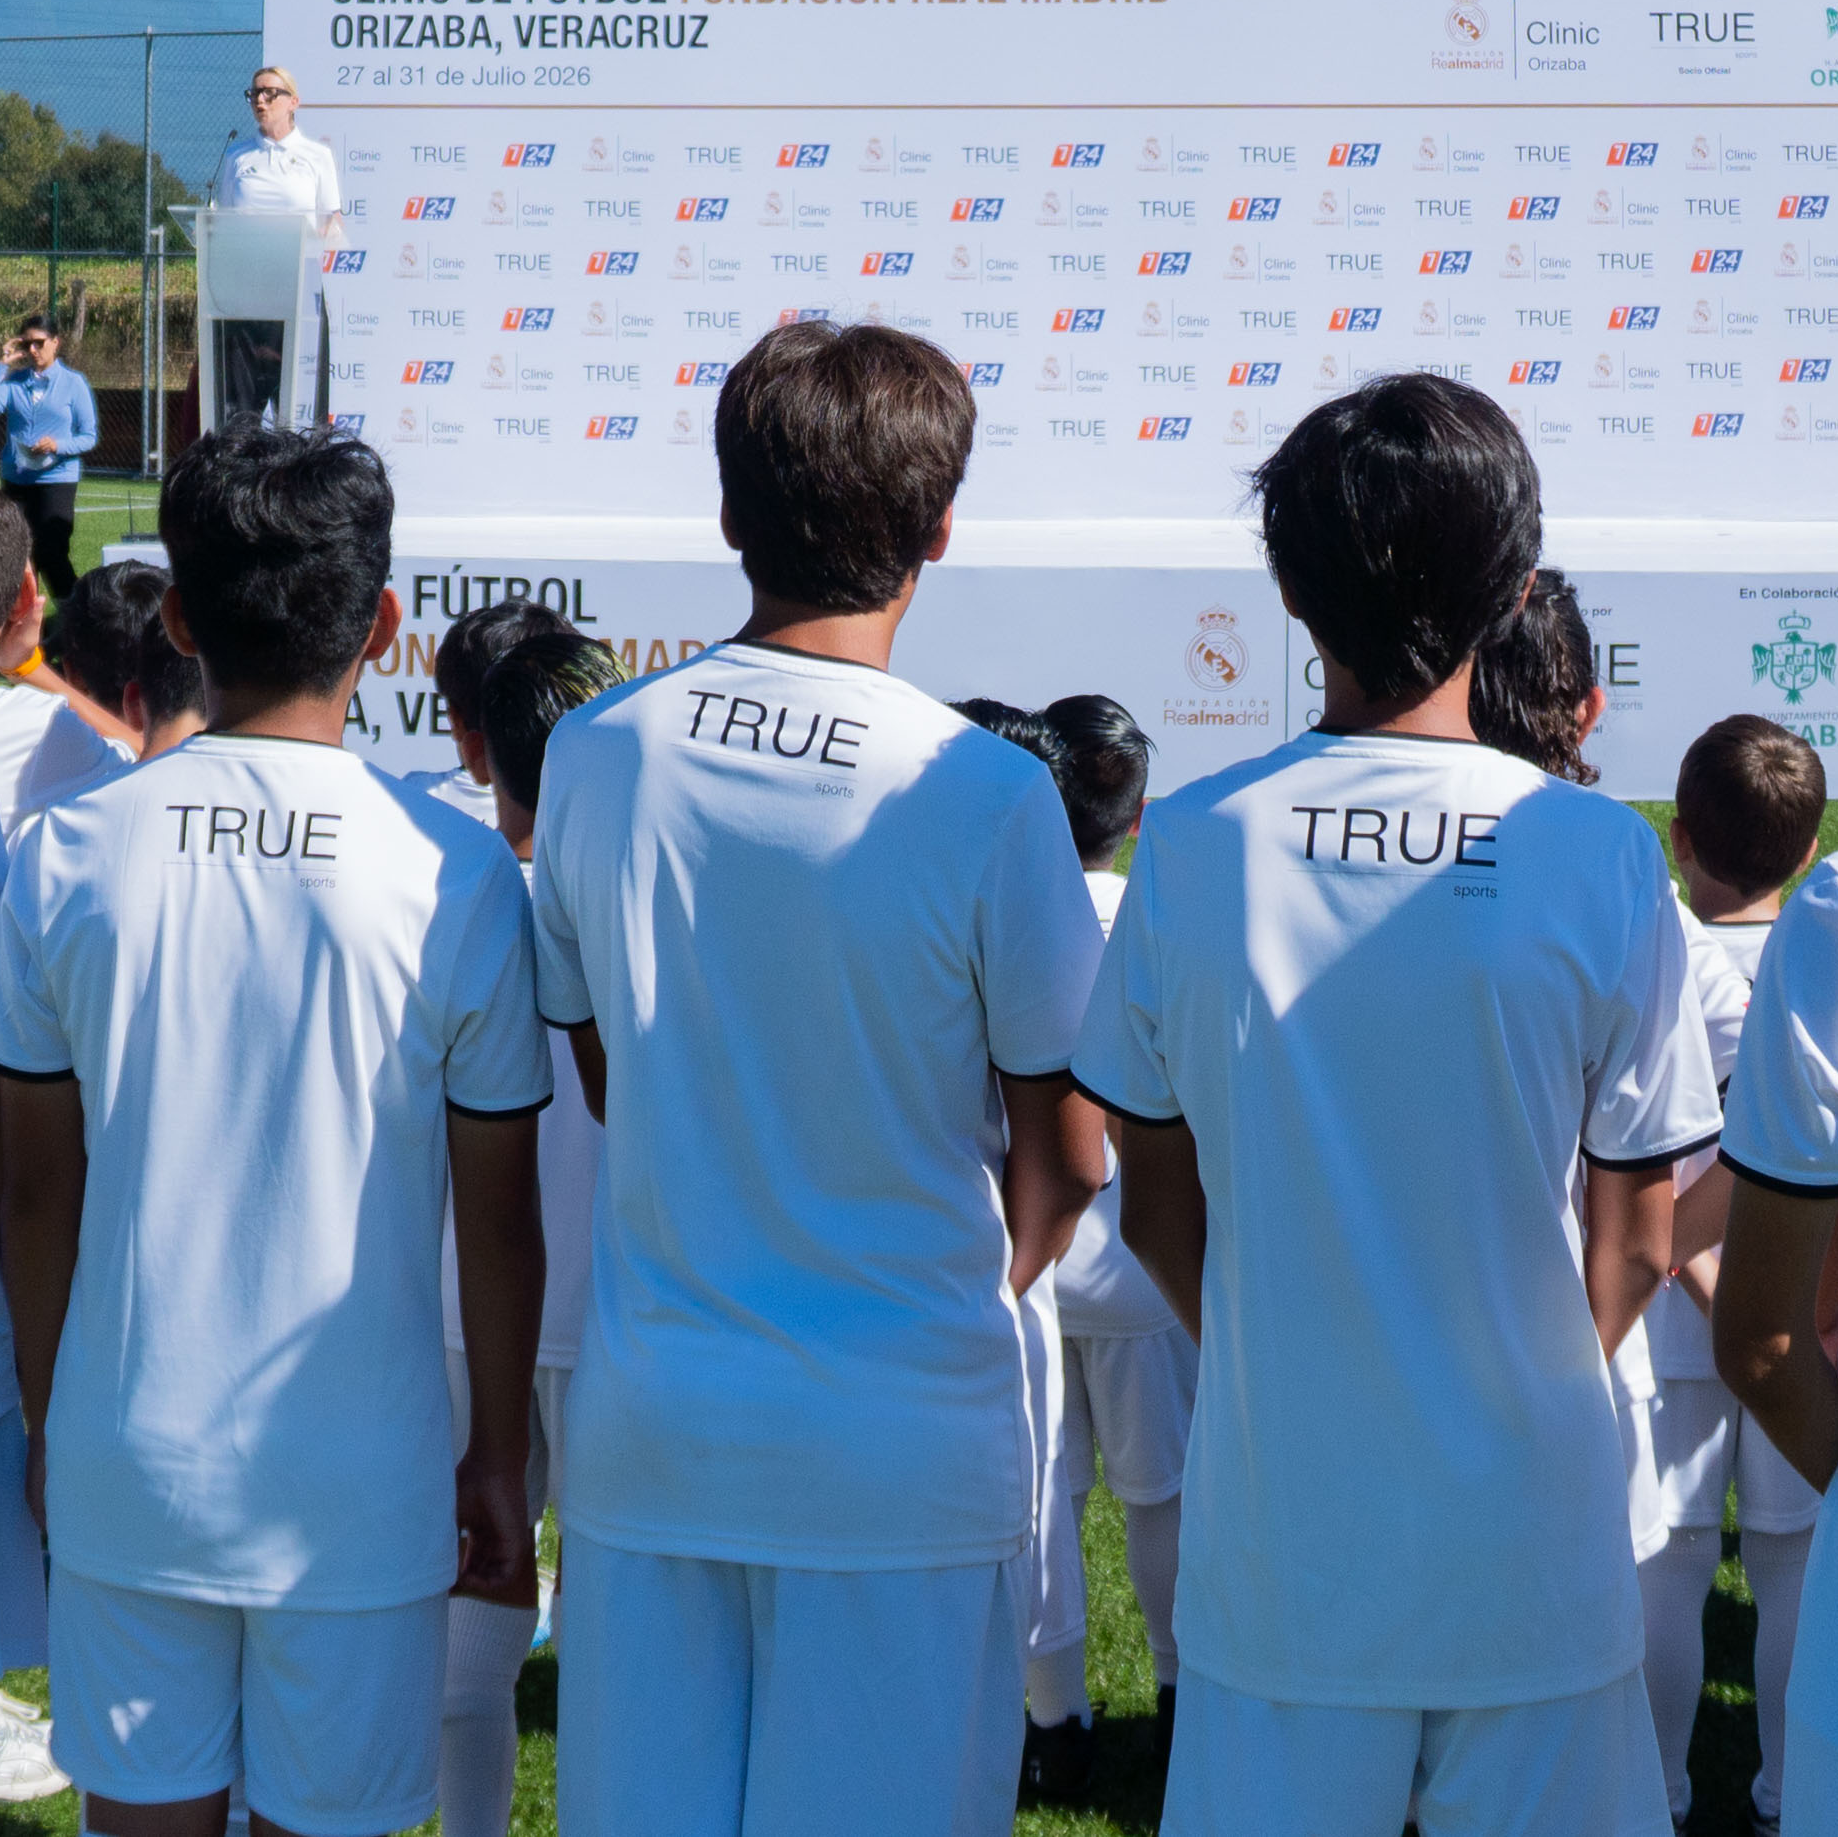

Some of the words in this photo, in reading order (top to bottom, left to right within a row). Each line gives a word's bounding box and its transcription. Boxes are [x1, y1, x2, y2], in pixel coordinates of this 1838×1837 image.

[330, 12, 502, 56] ORIZABA,
[513, 14, 709, 49] VERACRUZ
[1526, 21, 1600, 45] Clinic
[1649, 13, 1755, 43] TRUE
[1431, 58, 1504, 70] Realmadrid
[1527, 57, 1586, 71] Orizaba
[337, 66, 365, 86] 27
[373, 66, 393, 86] al
[400, 66, 426, 86] 31
[435, 66, 466, 86] de
[472, 66, 526, 86] Julio
[534, 66, 591, 86] 2026
[349, 149, 381, 161] Clinic
[411, 146, 466, 163] TRUE
[623, 150, 655, 162] Clinic
[685, 146, 742, 164] TRUE
[899, 150, 931, 162] Clinic
[961, 147, 1019, 164] TRUE
[1177, 150, 1209, 162] Clinic
[1239, 146, 1296, 163] TRUE
[1452, 149, 1485, 162] Clinic
[1515, 146, 1571, 162] TRUE
[1725, 149, 1757, 161] Clinic
[1782, 145, 1837, 162] TRUE
[522, 203, 554, 215] Clinic
[584, 200, 641, 217] TRUE
[798, 205, 830, 217] Clinic
[860, 201, 918, 218] TRUE
[1076, 204, 1108, 216] Clinic
[1139, 200, 1195, 218] TRUE
[1353, 204, 1385, 216] Clinic
[1415, 199, 1471, 216] TRUE
[1627, 202, 1659, 215] Clinic
[1685, 199, 1741, 215] TRUE
[433, 257, 465, 269] Clinic
[495, 254, 551, 271] TRUE
[708, 258, 741, 270] Clinic
[771, 255, 827, 272] TRUE
[986, 259, 1019, 271] Clinic
[1048, 255, 1105, 272] TRUE
[1264, 258, 1296, 270] Clinic
[1326, 254, 1383, 271] TRUE
[1539, 256, 1571, 269] Clinic
[1597, 251, 1653, 270] TRUE
[347, 312, 379, 324] Clinic
[408, 310, 464, 327] TRUE
[621, 314, 654, 327] Clinic
[683, 311, 741, 328] TRUE
[899, 315, 931, 327] Clinic
[961, 312, 1019, 329] TRUE
[1177, 315, 1209, 327] Clinic
[1239, 311, 1296, 328] TRUE
[1454, 314, 1486, 326] Clinic
[1515, 309, 1571, 327] TRUE
[1727, 312, 1759, 324] Clinic
[1784, 308, 1838, 325] TRUE
[521, 368, 553, 380] Clinic
[583, 365, 640, 382] TRUE
[1076, 370, 1109, 381] Clinic
[1139, 366, 1195, 382] TRUE
[1628, 367, 1660, 378] Clinic
[1686, 362, 1742, 379] TRUE
[432, 421, 464, 434] Clinic
[493, 418, 550, 436] TRUE
[986, 424, 1018, 435] Clinic
[1048, 420, 1106, 437] TRUE
[1539, 420, 1571, 432] Clinic
[1598, 417, 1654, 434] TRUE
[1740, 588, 1757, 599] En
[1592, 608, 1612, 619] por
[1163, 698, 1269, 707] FUNDACIÓN
[1163, 710, 1269, 726] Realmadrid
[688, 690, 869, 769] TRUE
[813, 782, 855, 799] sports
[166, 805, 342, 861] TRUE
[1292, 805, 1501, 868] TRUE
[299, 876, 336, 889] sports
[1453, 884, 1498, 899] sports
